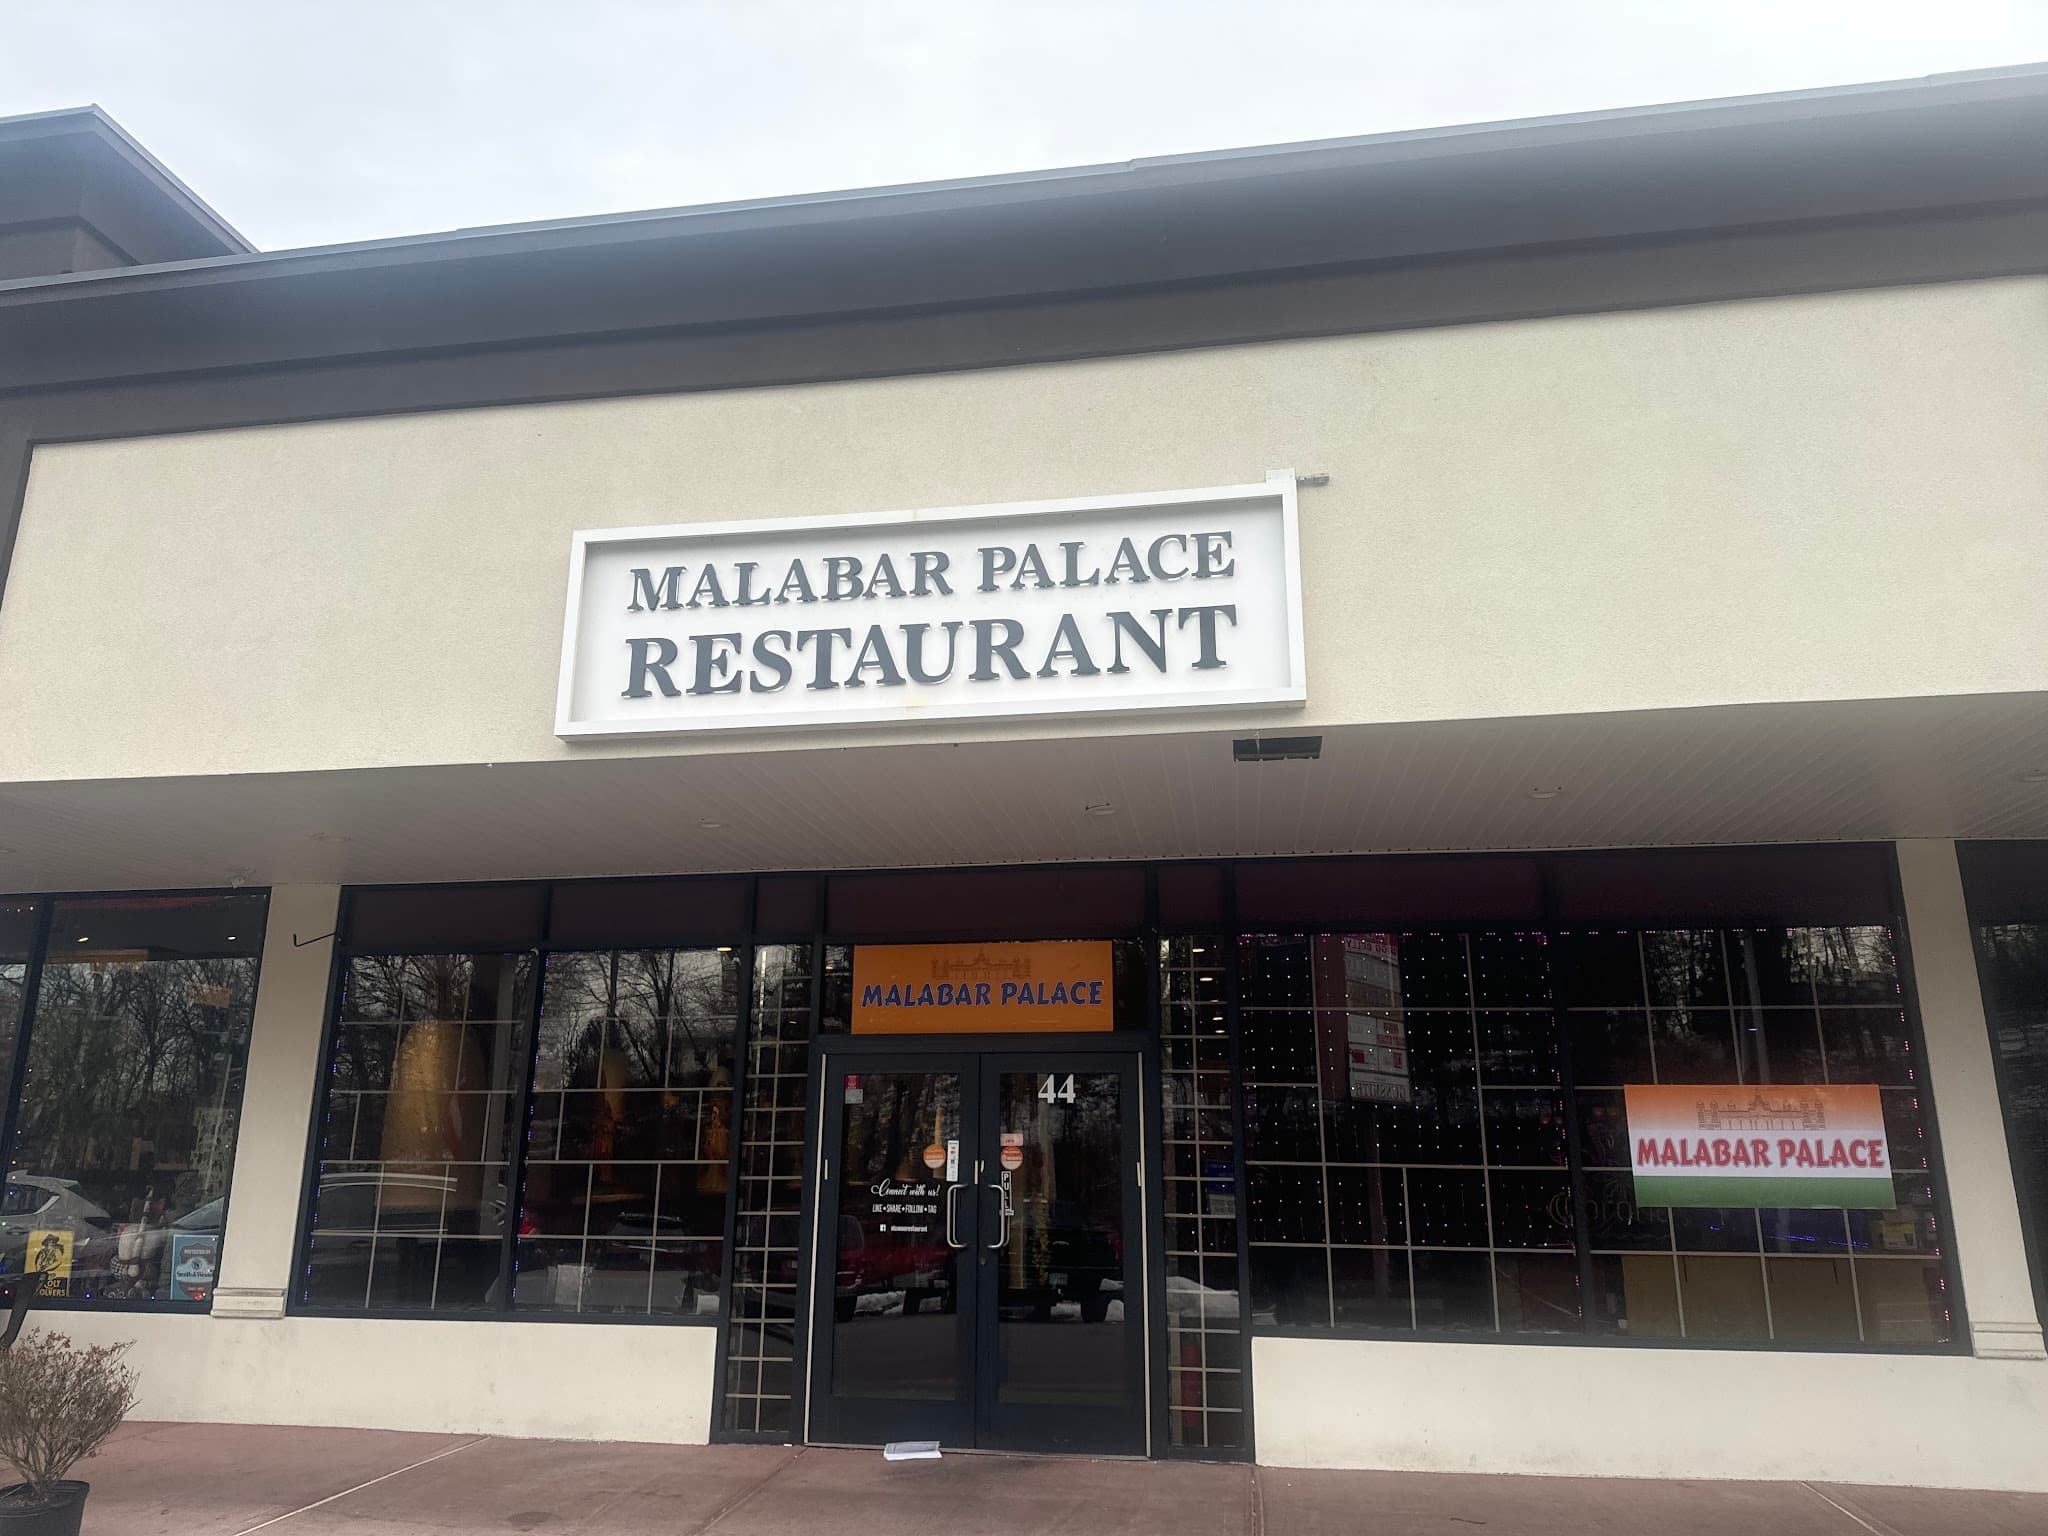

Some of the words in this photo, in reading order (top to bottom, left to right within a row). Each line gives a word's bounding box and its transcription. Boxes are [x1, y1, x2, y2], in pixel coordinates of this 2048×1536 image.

[626, 549, 953, 613] MALABAR
[977, 530, 1236, 593] PALACE
[621, 604, 1237, 700] RESTAURANT
[861, 982, 992, 1008] MALABAR
[1001, 980, 1105, 1006] PALACE
[1038, 1073, 1076, 1104] 44
[1636, 1136, 1773, 1168] MALABAR
[1777, 1137, 1885, 1169] PALACE
[871, 1178, 912, 1197] Connect
[909, 1184, 926, 1196] with
[872, 1203, 883, 1213] LIKE
[886, 1203, 902, 1213] SHARE
[905, 1204, 924, 1214] FOLLOW
[928, 1204, 937, 1214] TAG
